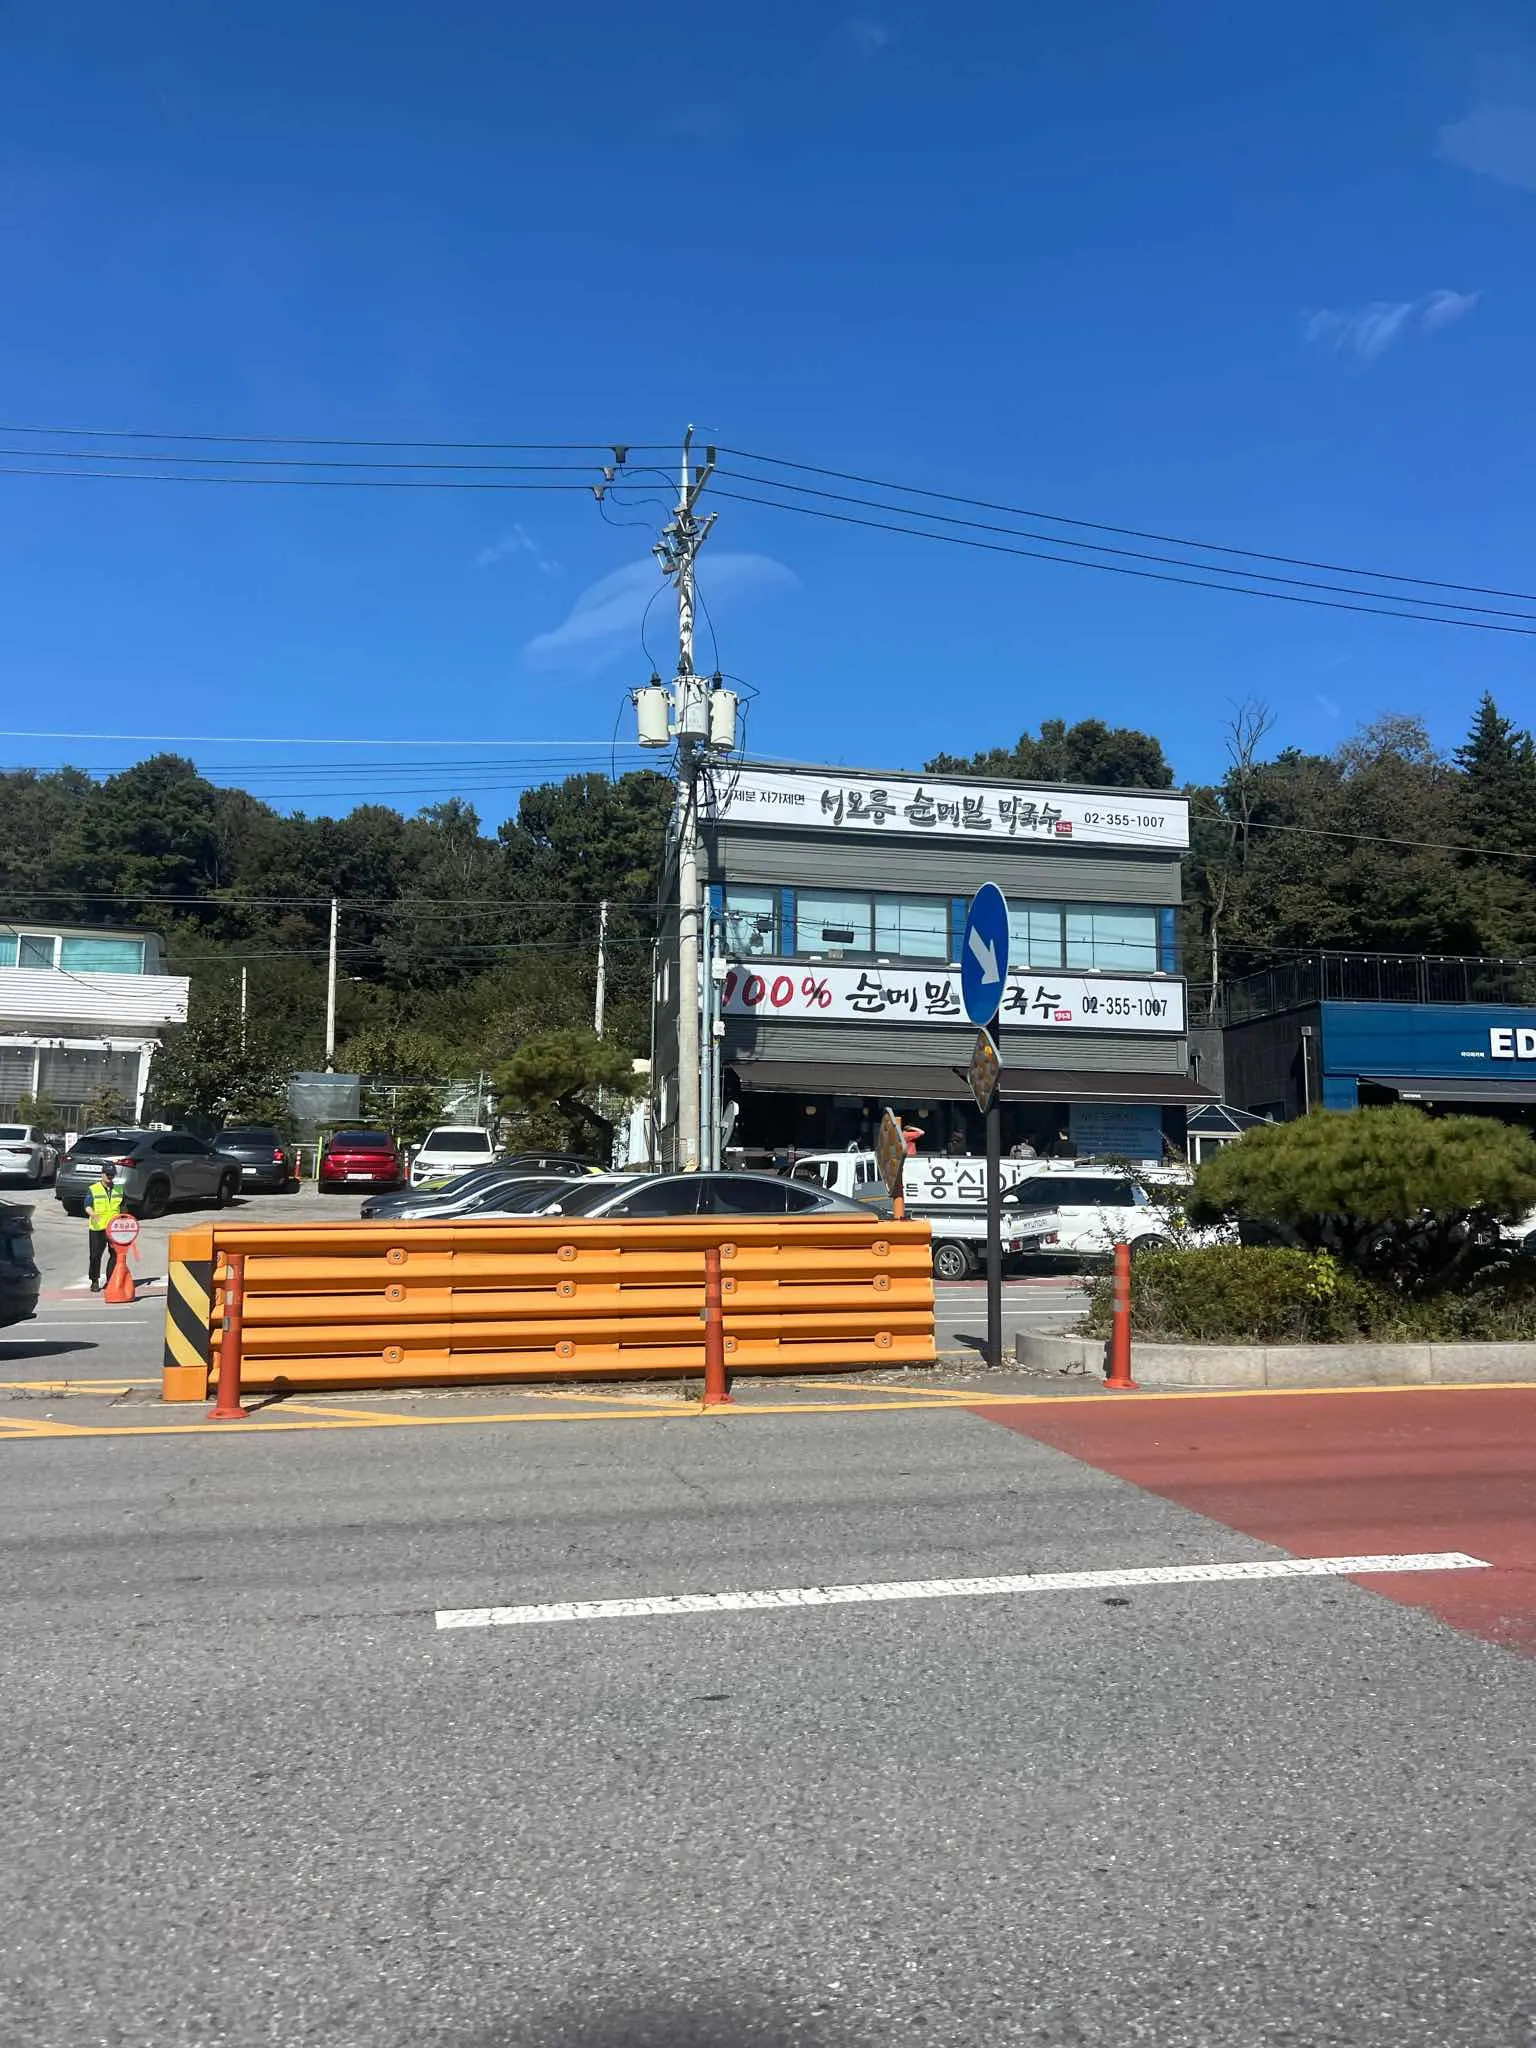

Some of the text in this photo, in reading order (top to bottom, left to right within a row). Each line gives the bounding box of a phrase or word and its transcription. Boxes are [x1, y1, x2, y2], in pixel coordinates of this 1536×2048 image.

[759, 790, 805, 806] 자가제면
[821, 787, 1062, 835] 서오릉 순메밀 막국수
[1084, 812, 1165, 828] 02-355-1007
[721, 972, 1062, 1019] 100% 순메밀 국수
[1082, 996, 1168, 1017] 02-355-1007
[1490, 1028, 1536, 1058] ED
